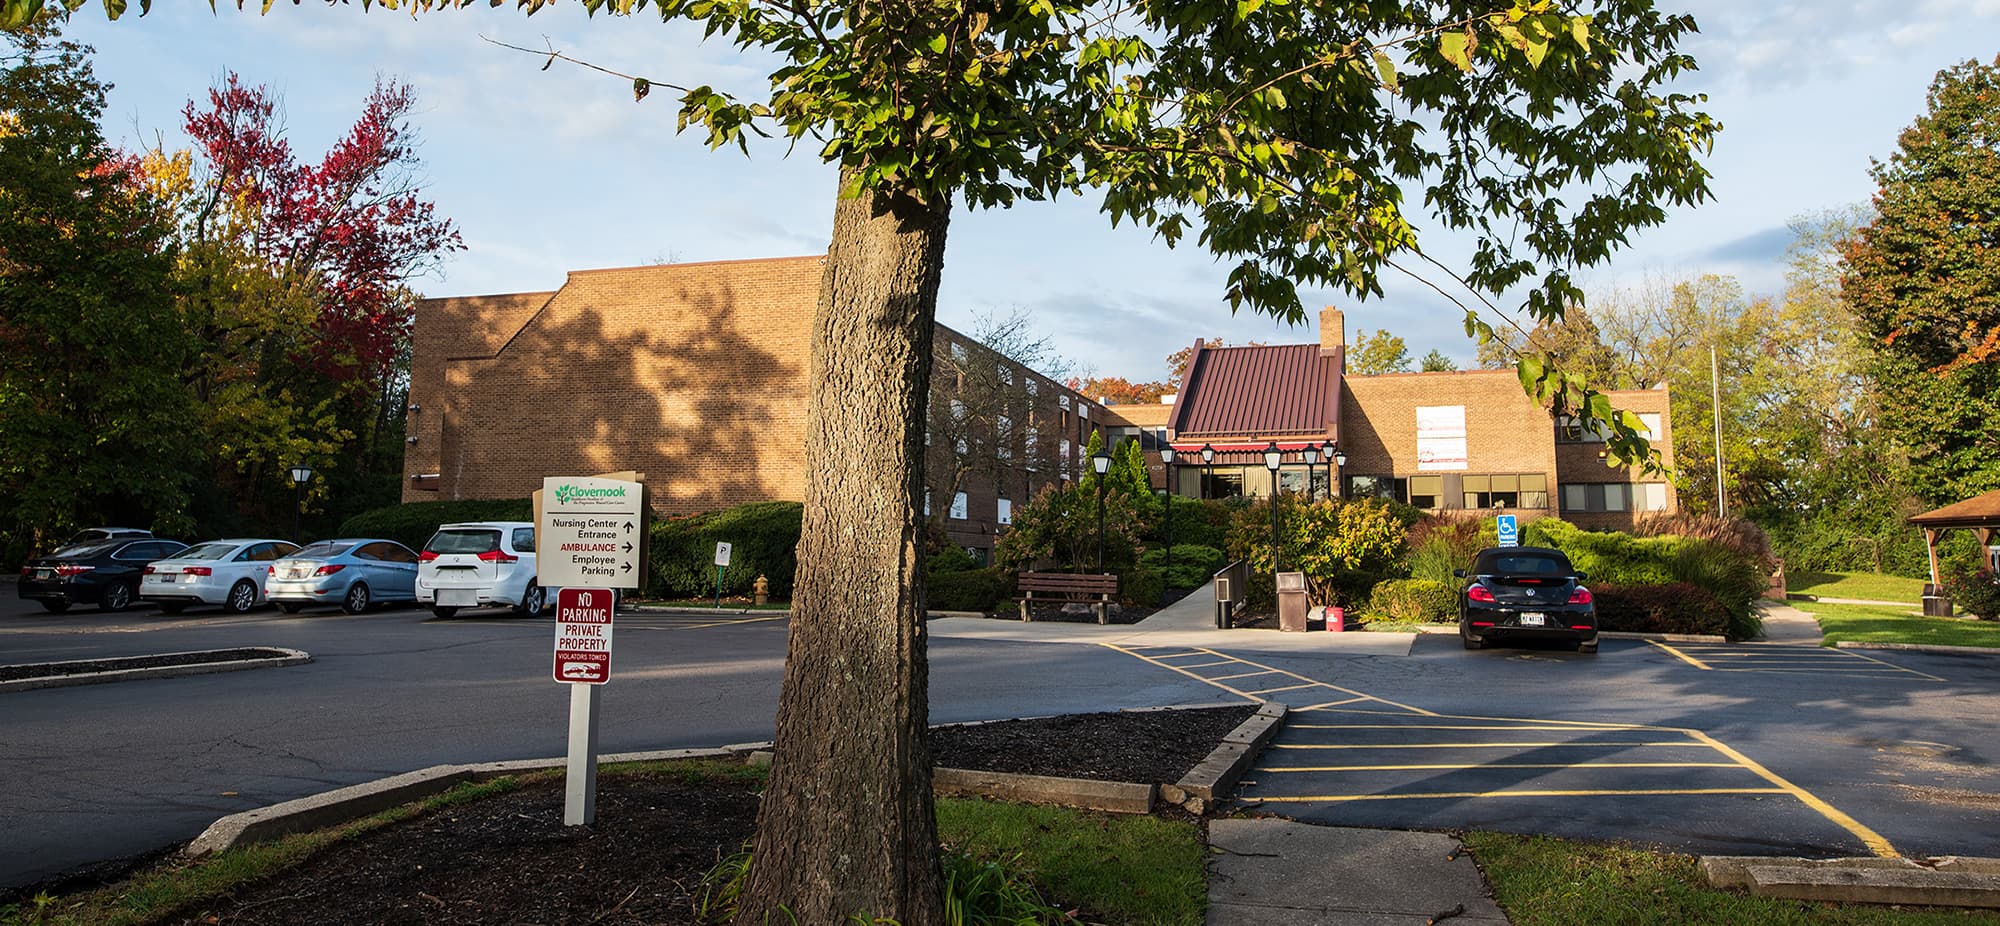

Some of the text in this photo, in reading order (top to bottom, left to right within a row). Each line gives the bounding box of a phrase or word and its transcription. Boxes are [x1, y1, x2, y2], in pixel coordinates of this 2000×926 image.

[569, 486, 626, 497] Clovernook
[552, 518, 618, 529] Nursing Center
[578, 530, 617, 539] Entrance
[560, 544, 616, 552] AMBULANCE
[572, 554, 616, 565] Employee
[582, 566, 615, 576] Parking
[578, 593, 592, 606] NO
[562, 608, 606, 622] PARKING
[565, 625, 602, 636] PRIVATE
[560, 638, 608, 650] PROPERTY
